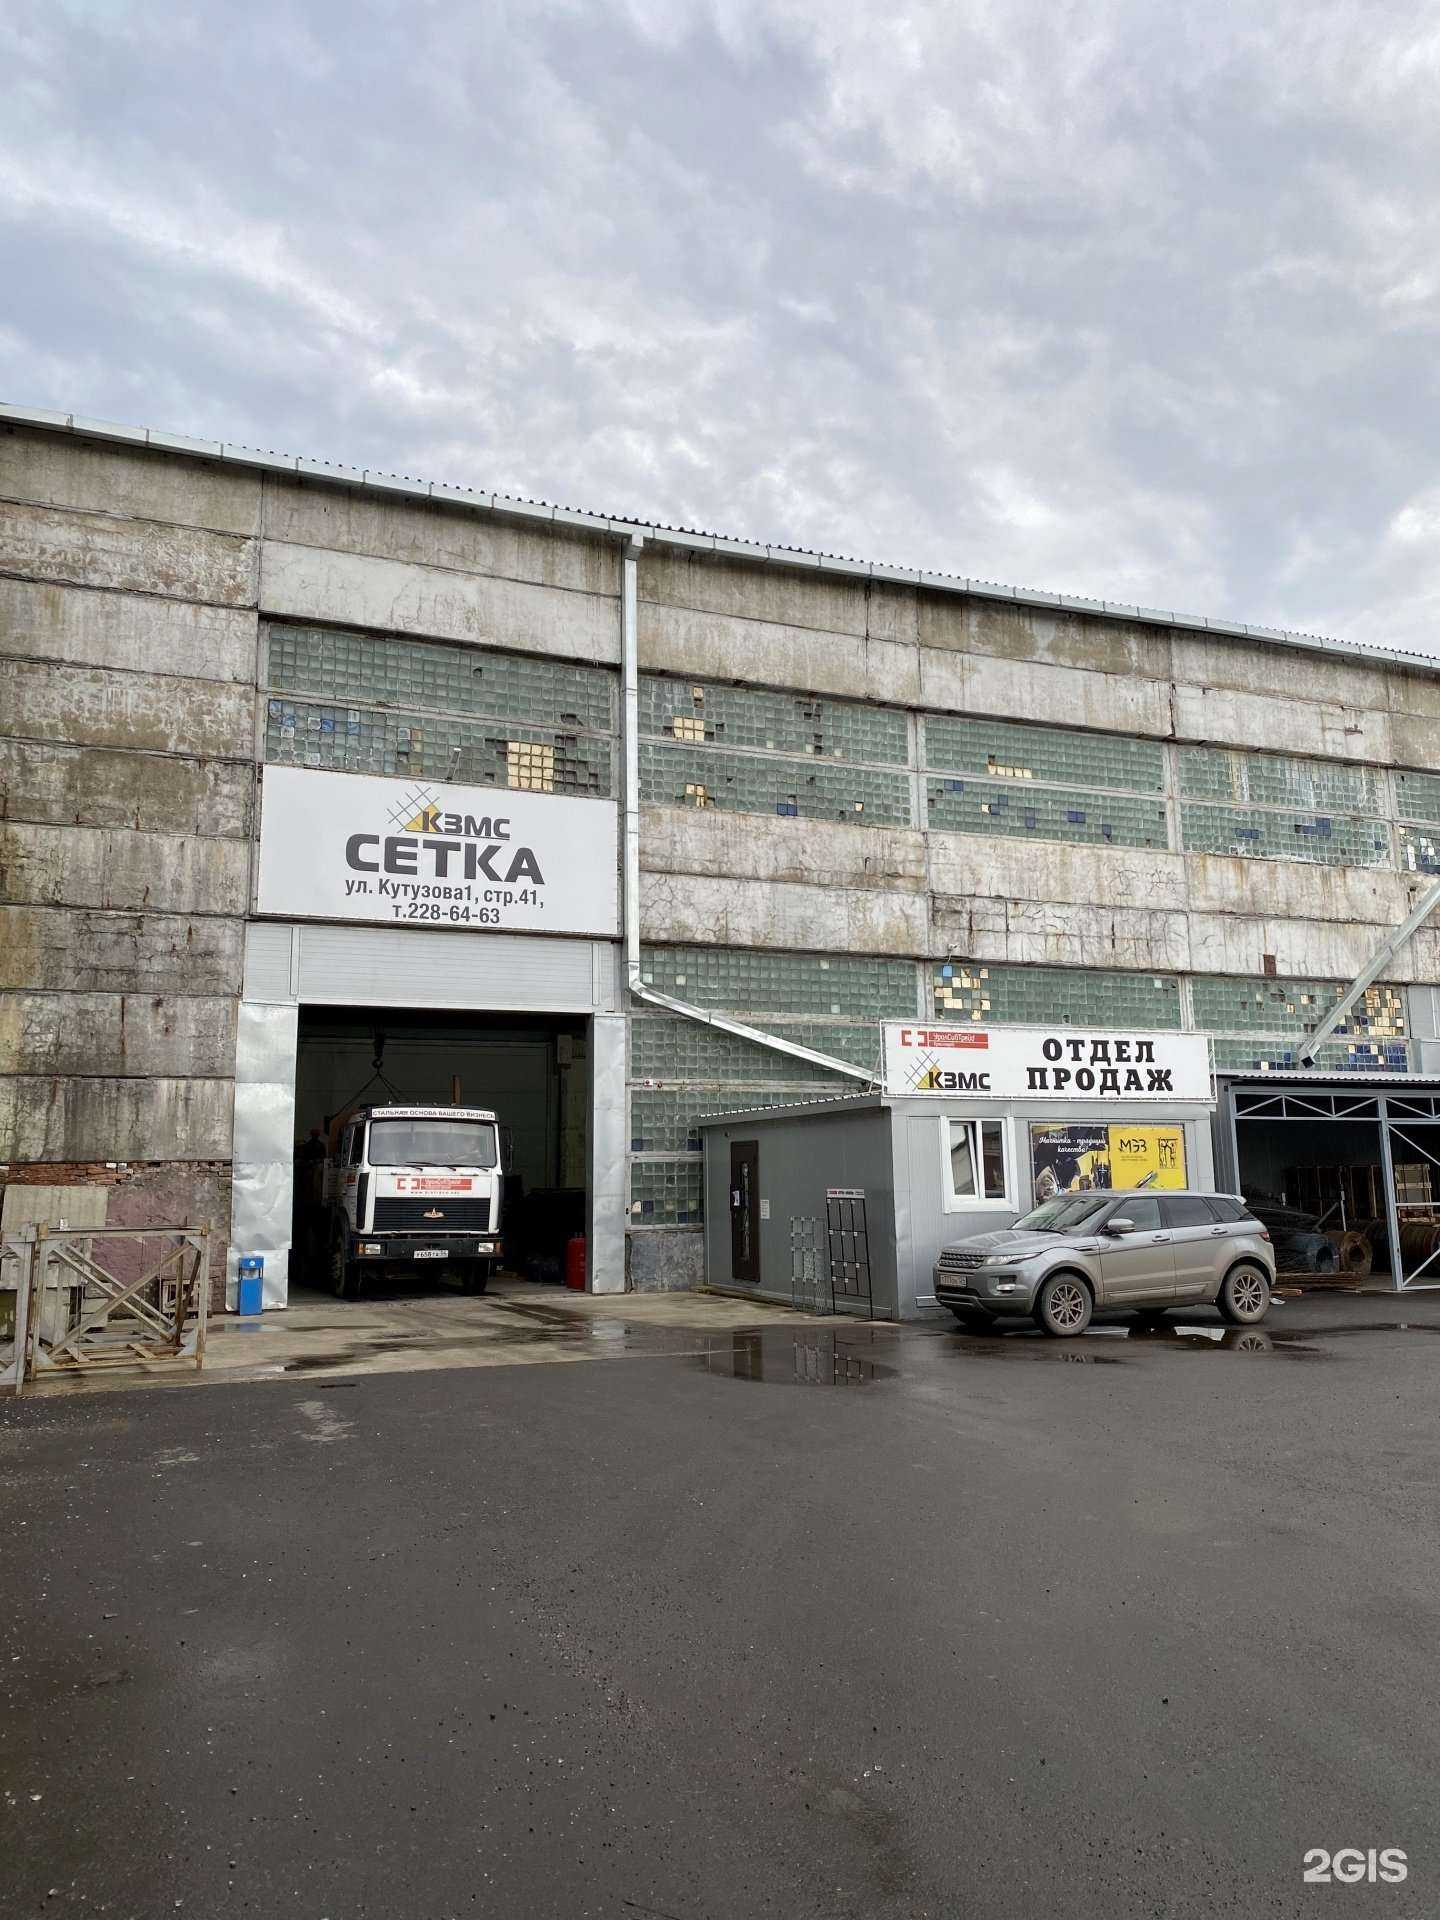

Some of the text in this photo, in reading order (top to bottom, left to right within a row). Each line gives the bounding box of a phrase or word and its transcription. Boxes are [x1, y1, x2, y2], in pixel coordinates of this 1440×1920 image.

[422, 811, 510, 839] КЗМС
[345, 833, 545, 885] СЕТКА
[345, 878, 545, 909] ул. Кутузова1, стр.41,
[392, 902, 501, 924] т.228-64-63
[1042, 1038, 1155, 1066] ОТДЕЛ
[928, 1071, 991, 1090] КЗМС
[1026, 1067, 1174, 1095] ПРОДАЖ
[438, 1110, 466, 1118] ВАШЕГО
